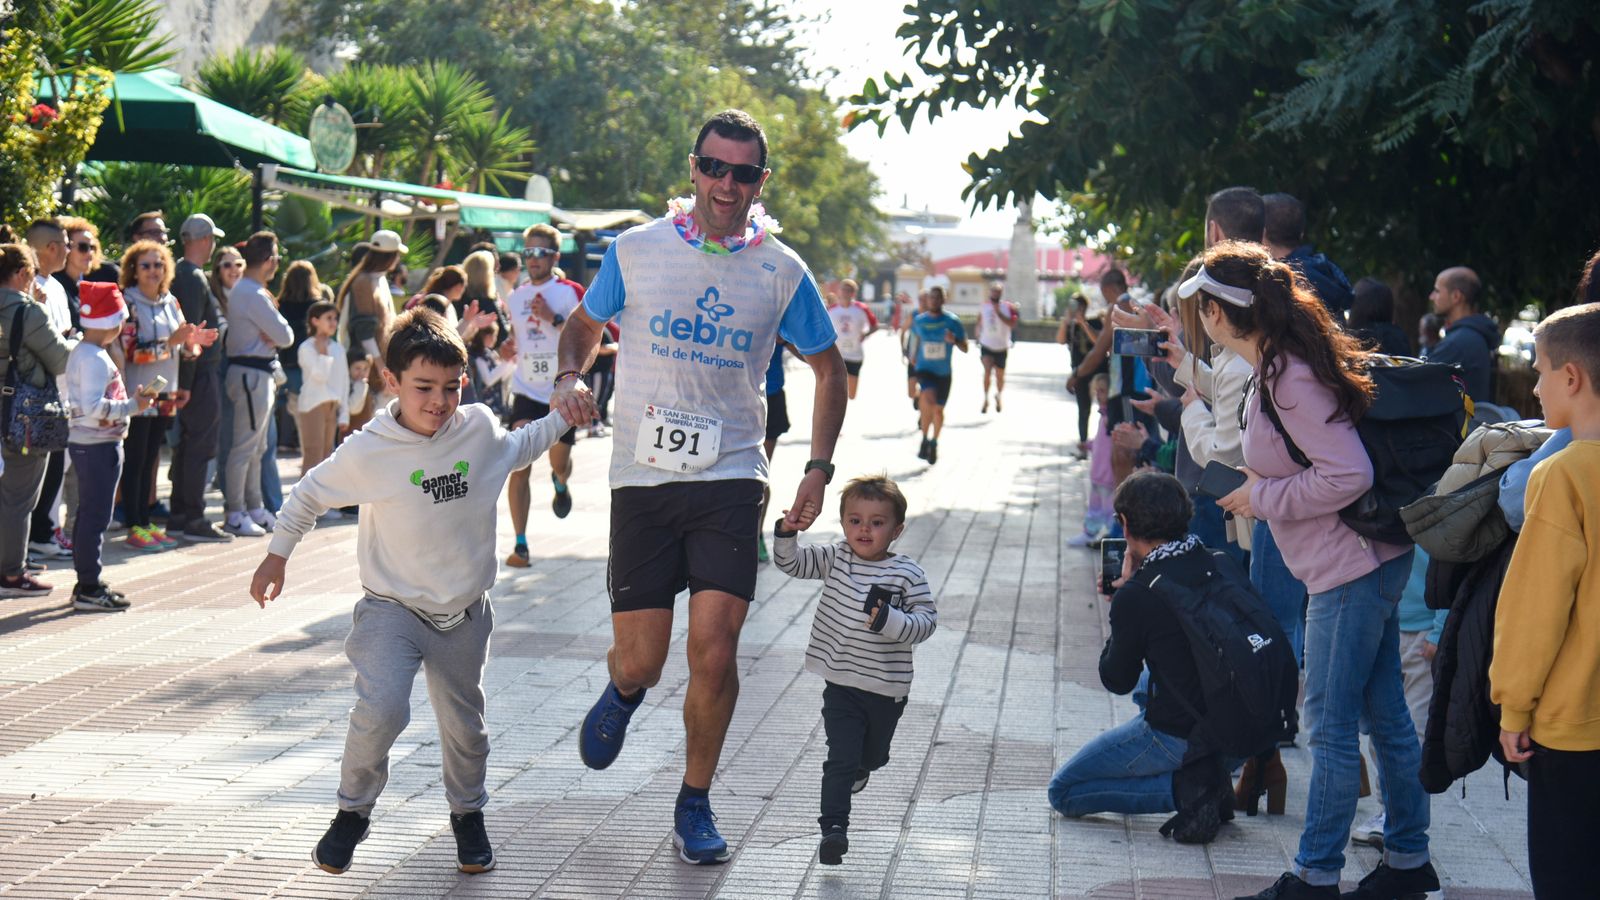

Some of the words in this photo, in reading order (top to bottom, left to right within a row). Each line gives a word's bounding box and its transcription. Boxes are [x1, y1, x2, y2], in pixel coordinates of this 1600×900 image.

[649, 309, 753, 352] debra
[532, 361, 549, 373] 38
[651, 343, 670, 357] Piel
[672, 348, 687, 361] de
[691, 351, 745, 370] Mariposa
[663, 410, 679, 419] SAN
[681, 413, 718, 427] SILVESTRE
[665, 418, 693, 428] TARIFEÑA
[694, 422, 708, 430] 2023
[653, 425, 700, 456] 191
[422, 472, 462, 494] gamer
[431, 480, 469, 501] VIBES
